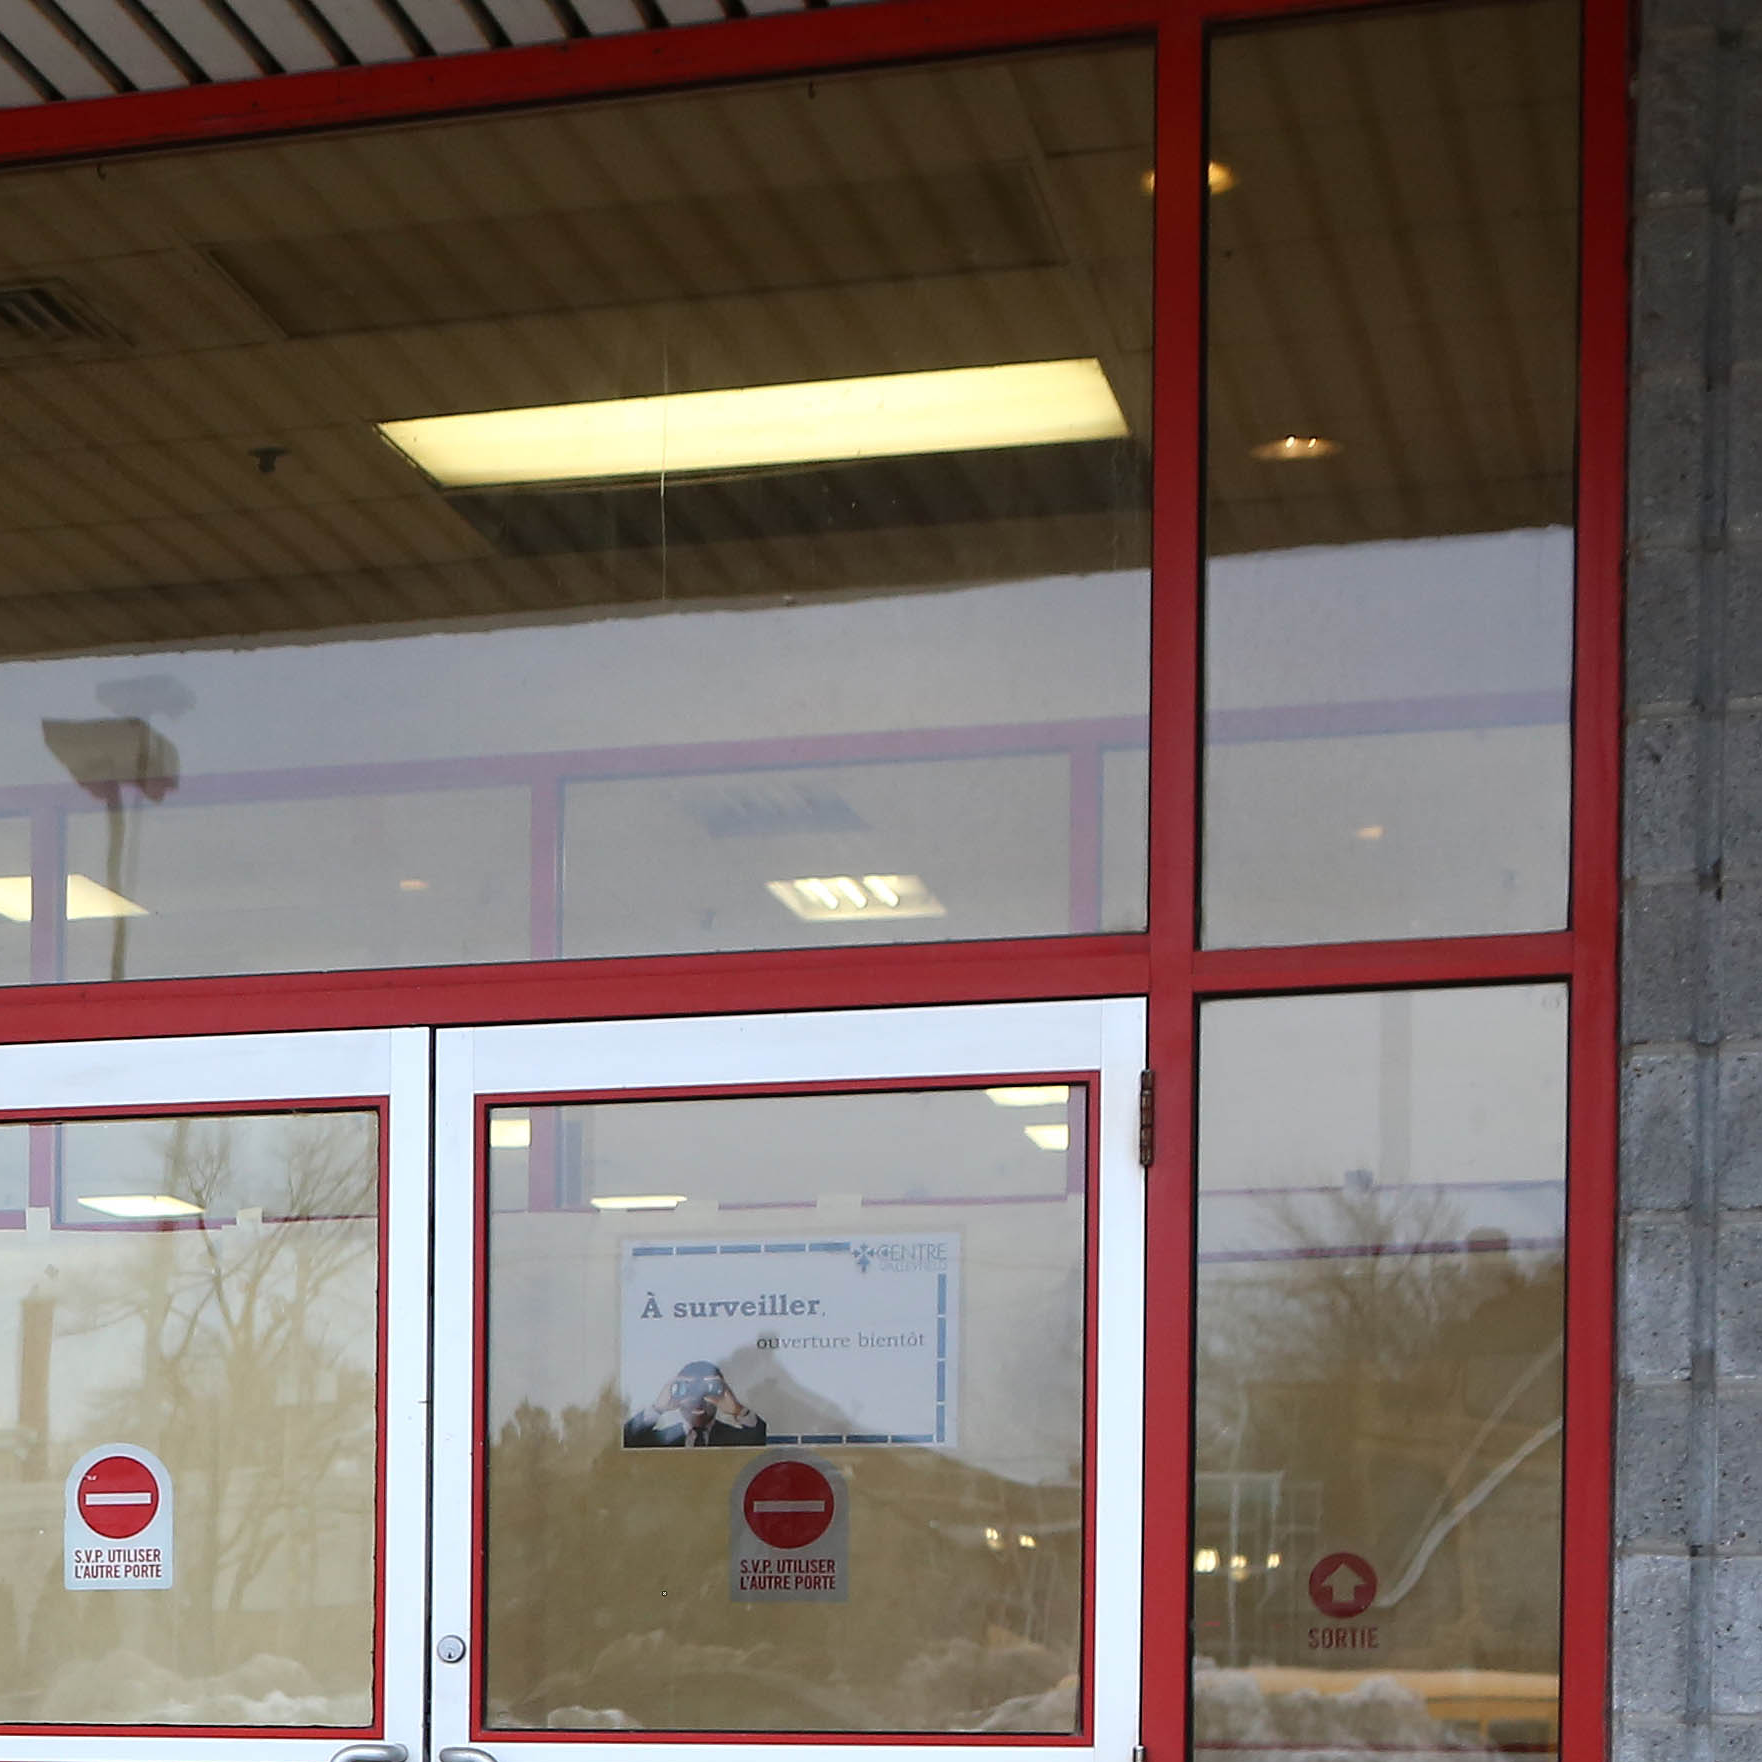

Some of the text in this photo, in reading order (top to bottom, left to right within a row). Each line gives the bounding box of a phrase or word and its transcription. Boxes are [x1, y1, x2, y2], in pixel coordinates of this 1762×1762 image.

[877, 1242, 948, 1263] CENTRE
[640, 1291, 663, 1319] À
[756, 1331, 925, 1350] ouverture bientôt
[74, 1548, 162, 1563] S.V.P. UTILISER
[74, 1564, 162, 1579] L'AUTRE PORTE
[739, 1559, 836, 1574] S.V.P. UTILISER
[739, 1575, 836, 1590] L'AUTRE PORTE
[1307, 1627, 1380, 1650] SORTIE
